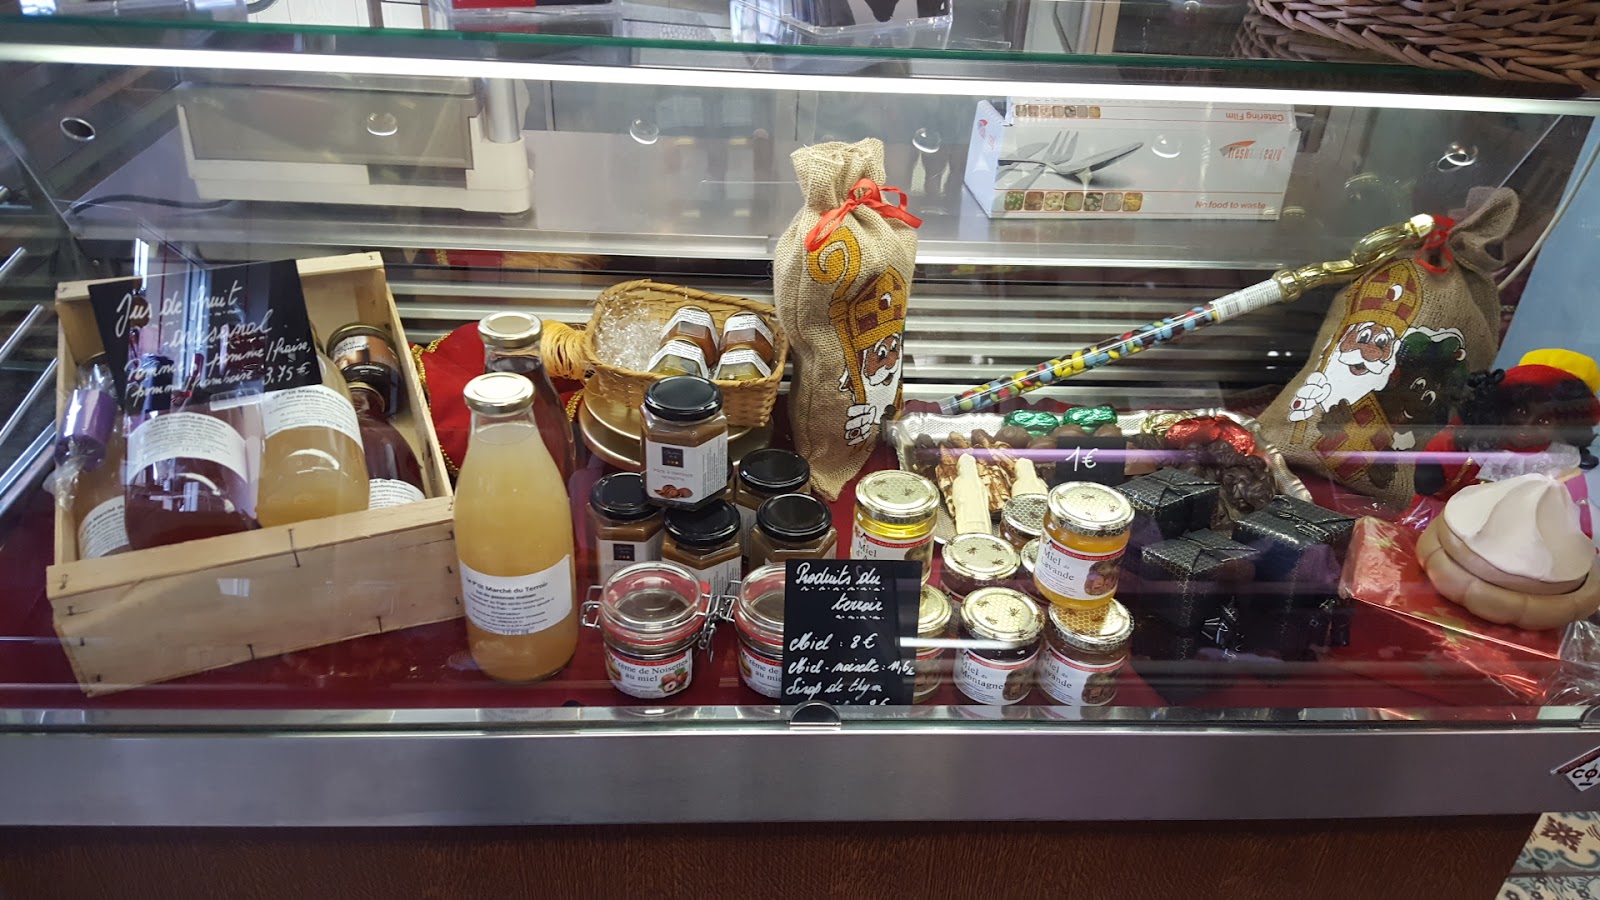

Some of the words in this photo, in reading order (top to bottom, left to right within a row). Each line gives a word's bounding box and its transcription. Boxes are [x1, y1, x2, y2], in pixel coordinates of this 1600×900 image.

[1225, 111, 1245, 121] Film
[1246, 111, 1284, 122] Catering
[1194, 200, 1207, 209] No
[1208, 200, 1228, 209] food
[1229, 201, 1239, 209] to
[1240, 202, 1266, 210] waste
[115, 293, 152, 338] Jus
[160, 290, 182, 316] de
[189, 280, 242, 321] fruit
[295, 361, 312, 377] €
[858, 541, 877, 558] Miel
[1043, 547, 1061, 566] Miel
[795, 562, 851, 586] Produits
[855, 567, 881, 586] du
[1041, 556, 1075, 581] Lavande
[485, 585, 512, 594] Marché
[525, 581, 548, 592] Terroir
[831, 592, 884, 612] terroir
[788, 631, 834, 651] Miel
[850, 634, 861, 650] 8
[862, 633, 878, 650] €
[638, 667, 649, 675] de
[652, 659, 688, 675] Noisettes
[768, 667, 779, 675] de
[962, 656, 979, 676] Miel
[1044, 653, 1060, 674] Miel
[755, 670, 765, 678] au
[767, 674, 782, 682] mie
[961, 667, 1004, 690] Montagne
[1043, 667, 1072, 689] avande
[785, 677, 822, 701] Sirop
[824, 677, 844, 694] de
[848, 677, 882, 701] thym
